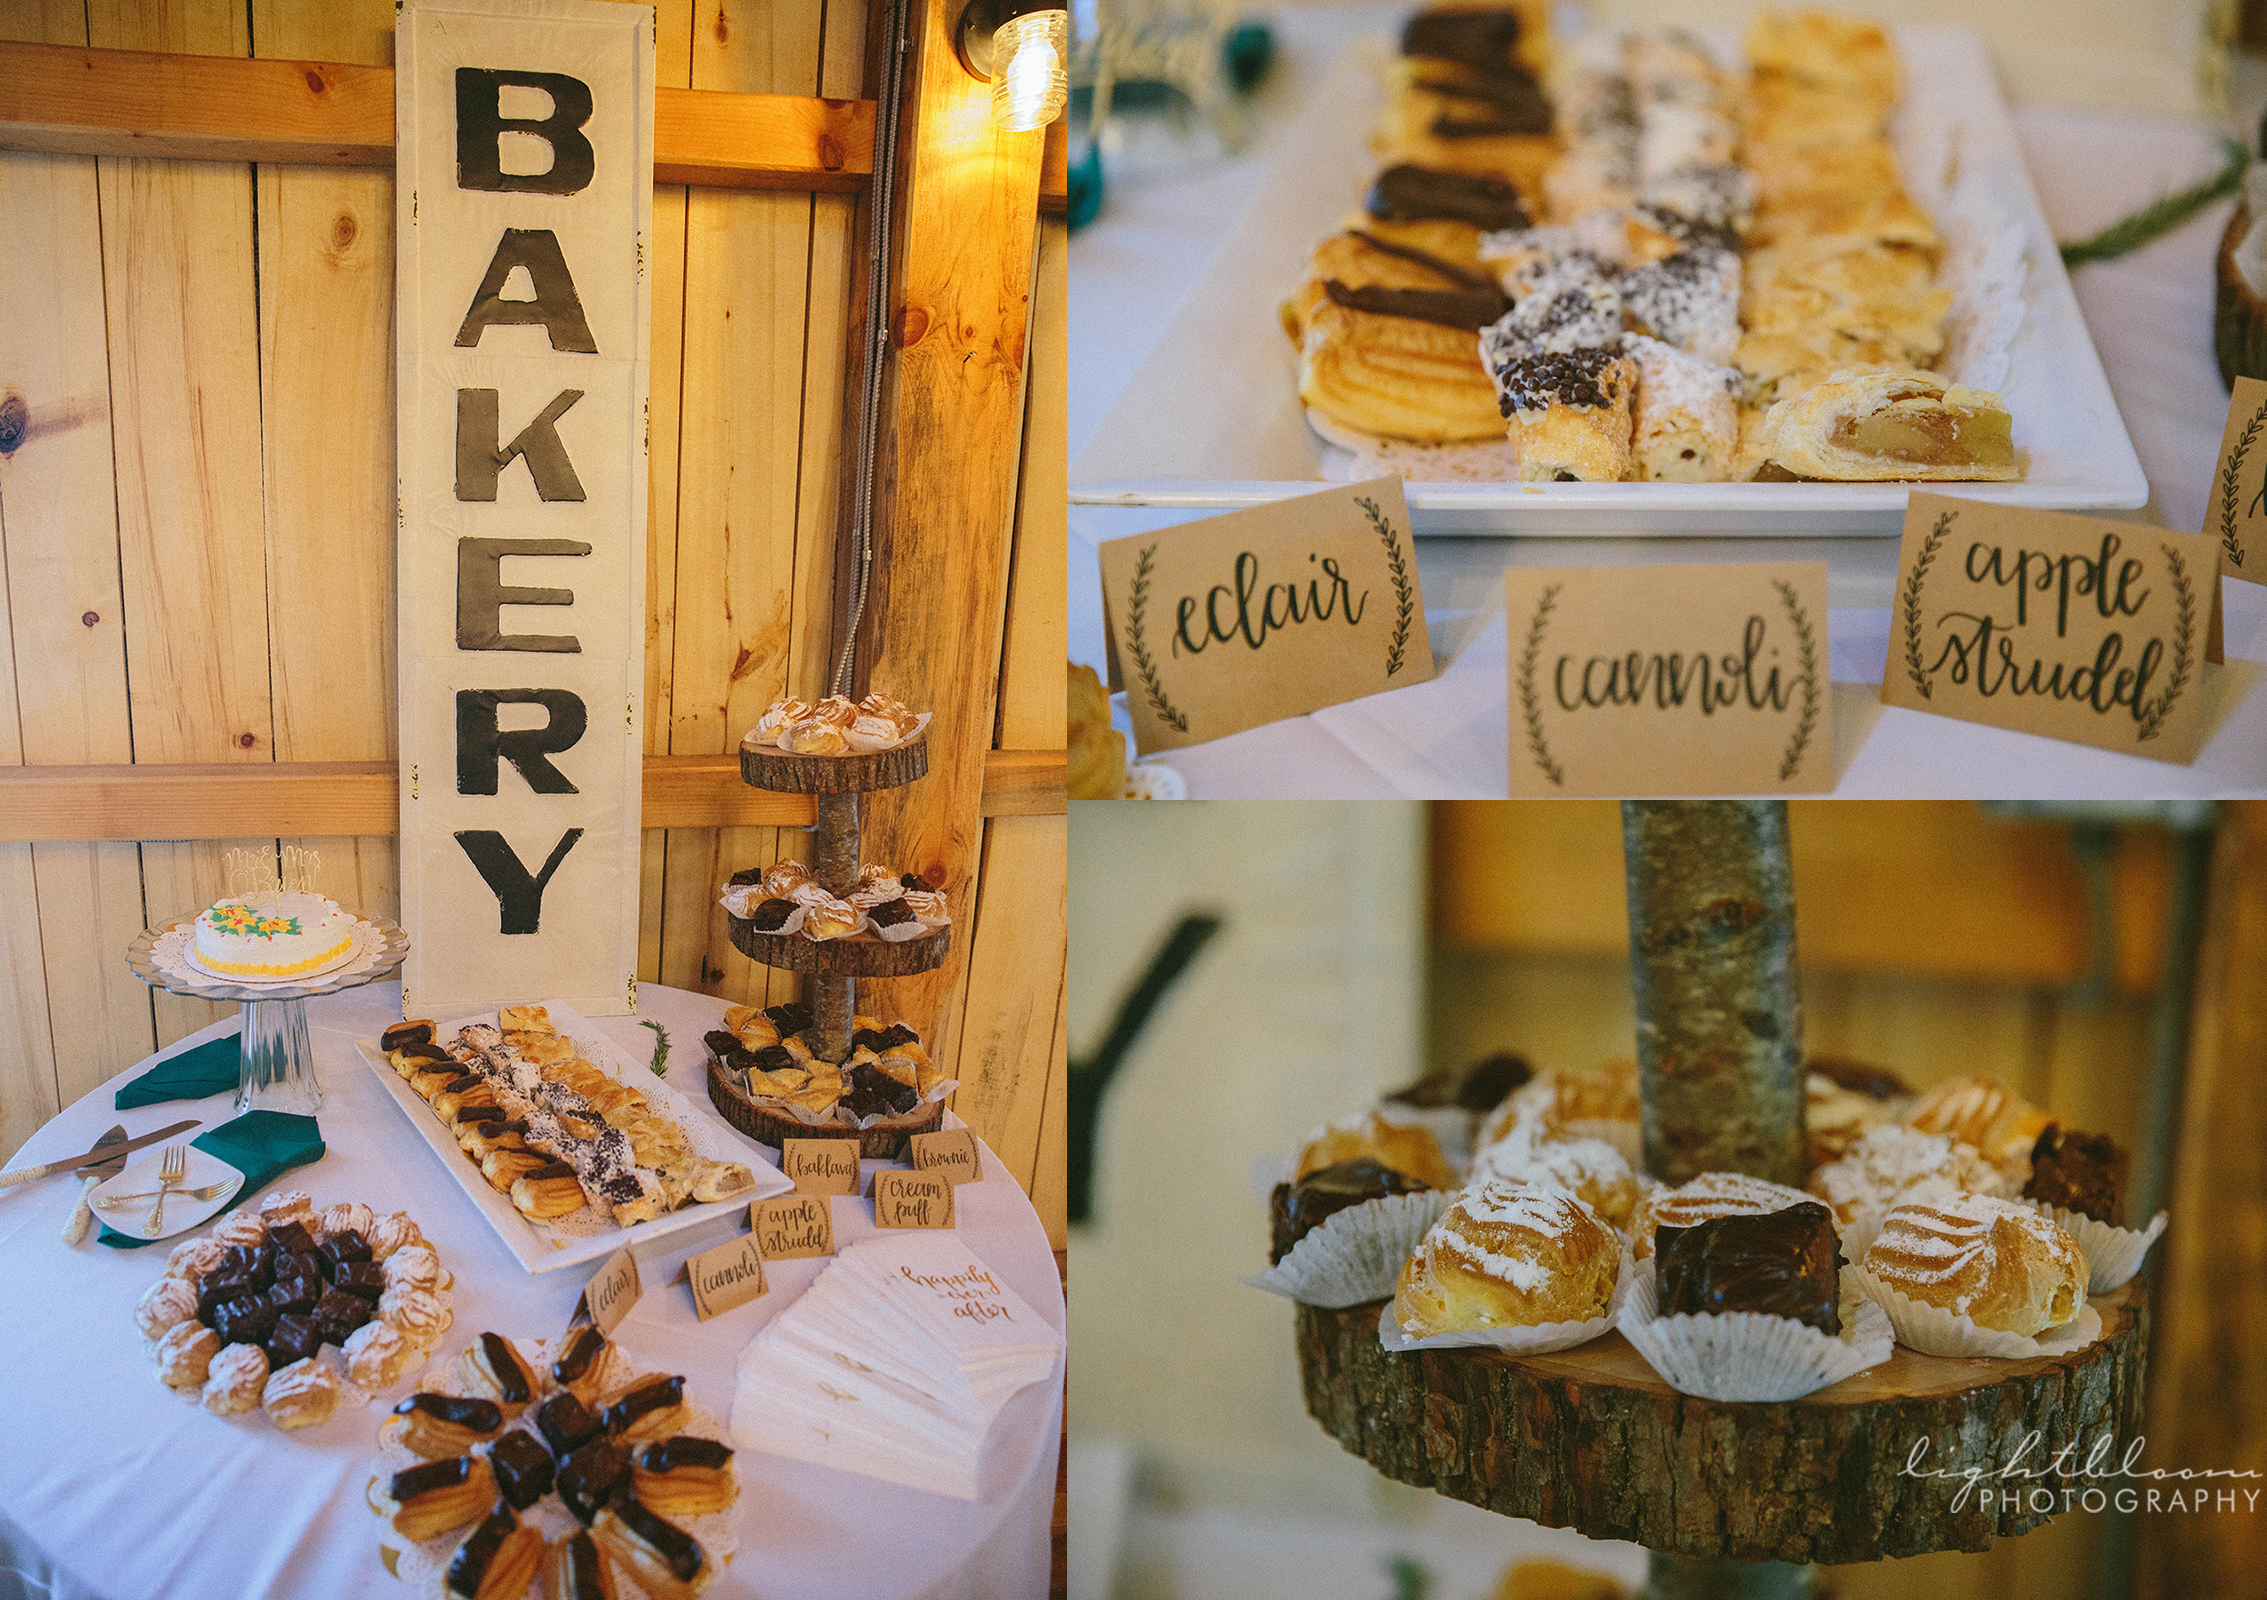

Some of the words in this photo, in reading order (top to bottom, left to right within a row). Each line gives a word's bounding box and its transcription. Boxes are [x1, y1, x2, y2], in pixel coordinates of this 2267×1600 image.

[453, 67, 599, 936] BAKERY
[1965, 533, 2151, 638] apple
[1172, 551, 1370, 660] eclair
[1554, 615, 1805, 717] cannoli
[1927, 611, 2165, 722] strudel
[796, 1153, 853, 1178] baklava
[922, 1148, 970, 1168] brownie
[890, 1179, 942, 1200] cream
[769, 1199, 817, 1231] apple
[893, 1199, 932, 1226] puff
[765, 1224, 825, 1253] strudel
[703, 1250, 758, 1294] cannoli
[900, 1264, 1001, 1296] happily
[953, 1300, 1018, 1325] after
